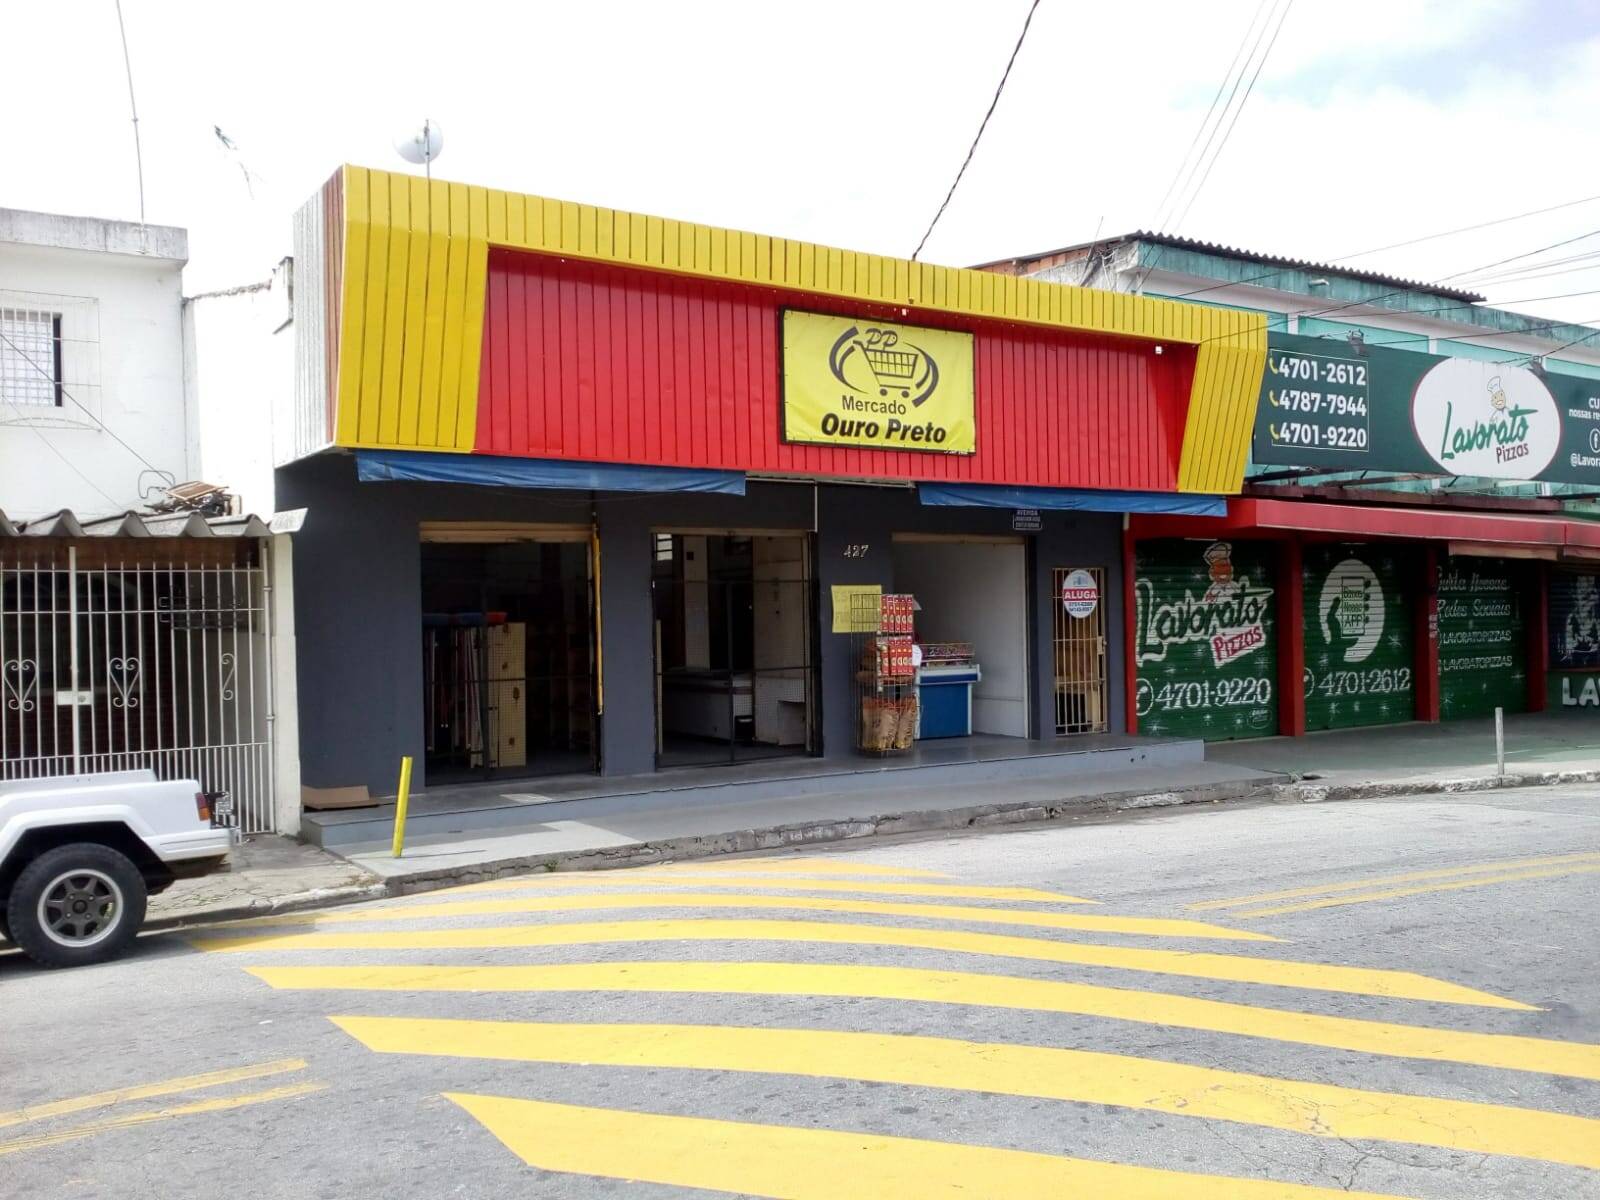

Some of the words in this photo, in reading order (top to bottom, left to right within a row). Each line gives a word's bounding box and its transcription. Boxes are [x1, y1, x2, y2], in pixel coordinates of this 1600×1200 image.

[1278, 357, 1367, 386] 4701-2612
[842, 395, 907, 415] Mercado
[1279, 389, 1367, 416] 4787-7944
[1568, 408, 1592, 420] nossas
[821, 413, 880, 438] Ouro
[885, 419, 947, 443] Preto
[1279, 422, 1367, 448] 4701-9220
[1440, 400, 1539, 460] Lavorato
[1495, 443, 1530, 464] Pizzas
[843, 544, 869, 558] 427
[1064, 590, 1097, 600] ALUGA
[1136, 578, 1274, 667] Lavorato
[1155, 677, 1272, 711] 4701-9220
[1318, 667, 1411, 697] 4701-2612
[1562, 677, 1600, 706] LA
